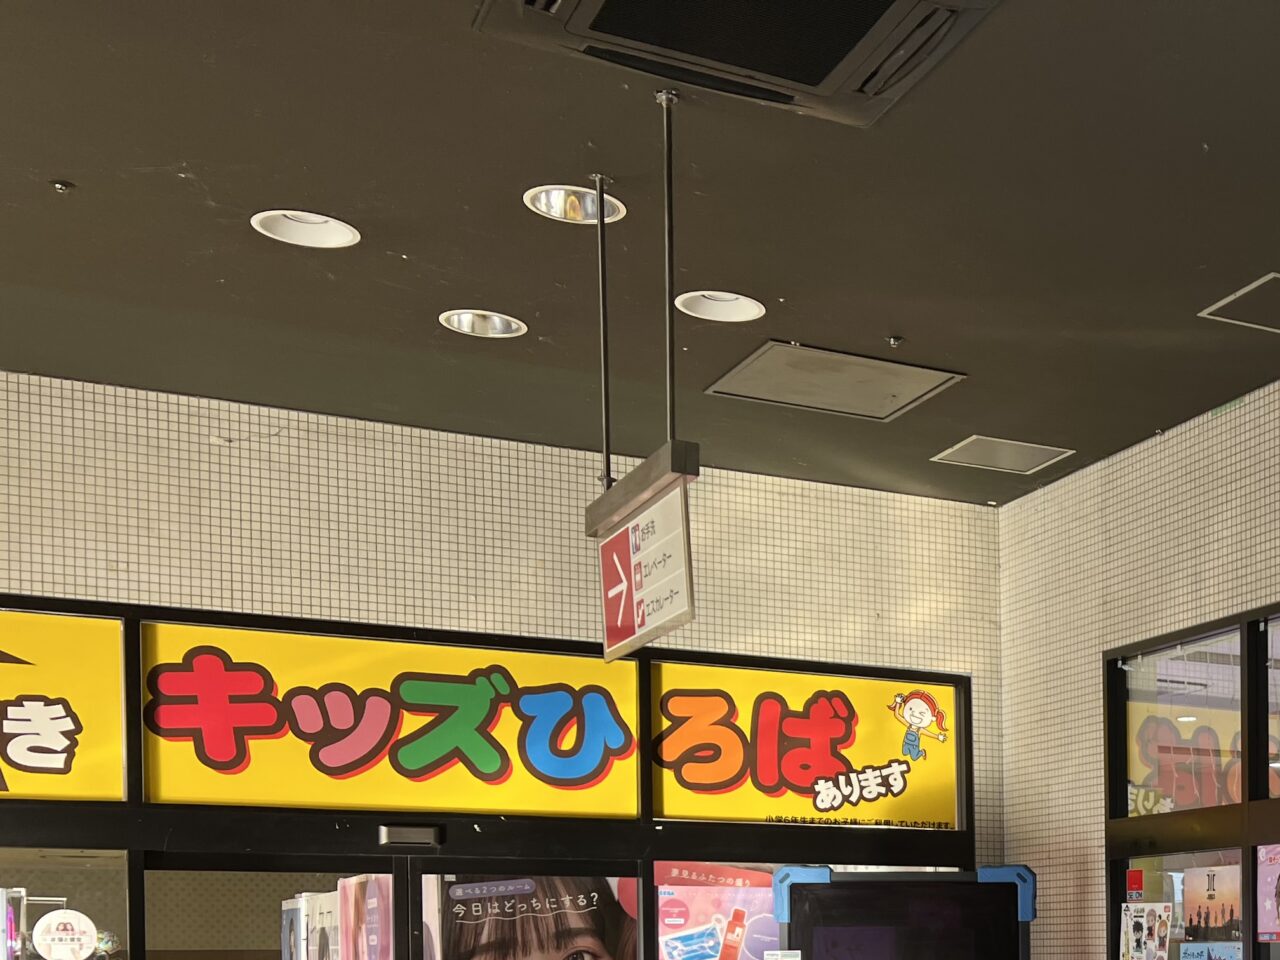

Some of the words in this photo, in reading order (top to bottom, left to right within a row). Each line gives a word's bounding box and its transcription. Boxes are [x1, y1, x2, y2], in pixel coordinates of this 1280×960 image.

[643, 553, 672, 579] エレベーター
[646, 589, 680, 617] エスカレーター
[812, 760, 911, 812] あります
